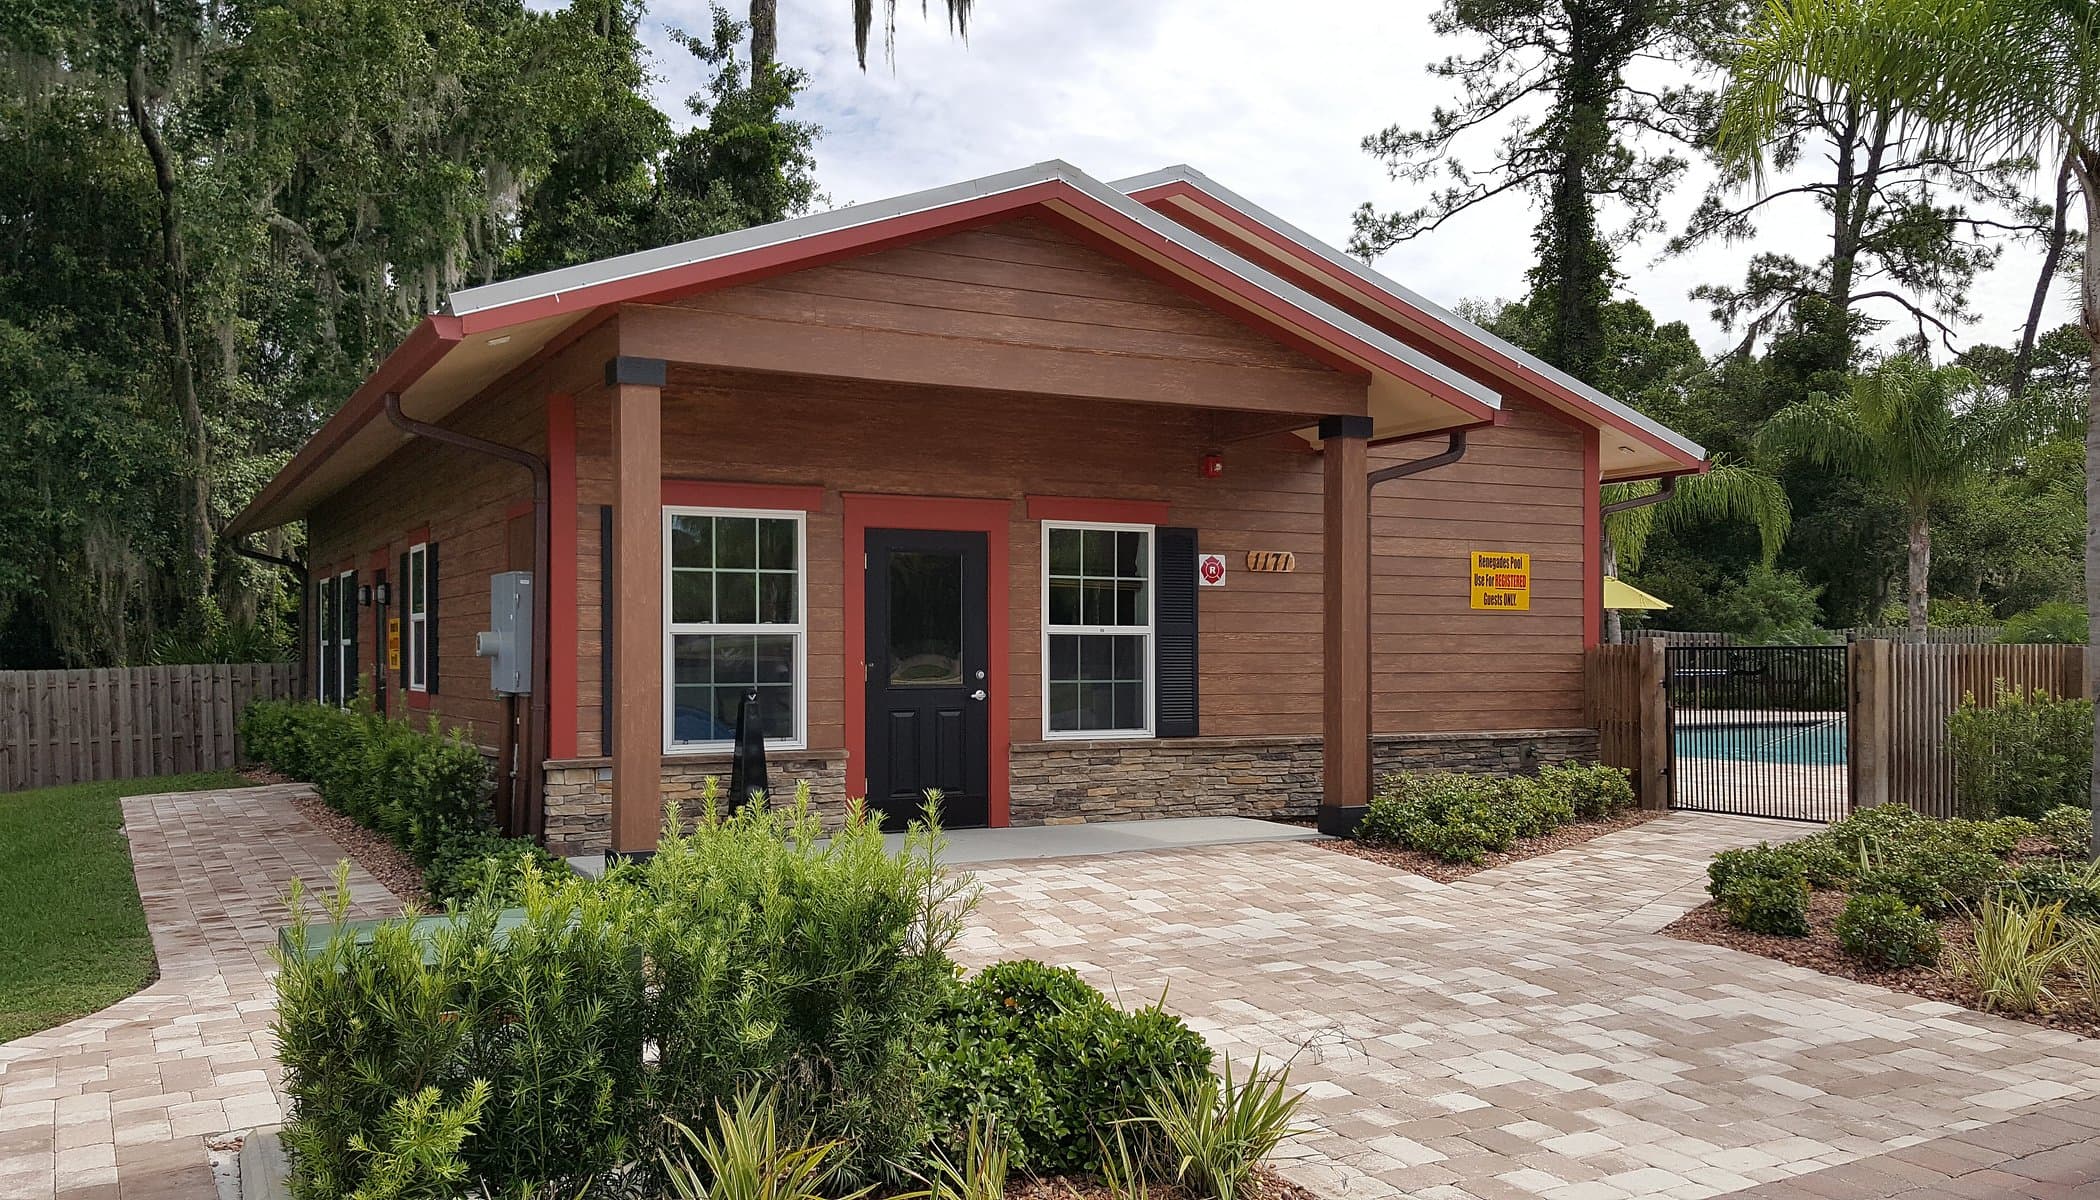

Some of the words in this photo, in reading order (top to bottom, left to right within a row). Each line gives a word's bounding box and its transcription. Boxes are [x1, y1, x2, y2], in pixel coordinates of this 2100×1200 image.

[1252, 552, 1290, 571] 1171
[1478, 555, 1509, 570] Renegades
[1510, 556, 1523, 569] Pool
[1209, 566, 1216, 575] R
[1474, 573, 1485, 587] Use
[1485, 573, 1495, 587] For
[1495, 574, 1527, 588] REGISTERED
[1483, 592, 1503, 606] Guests
